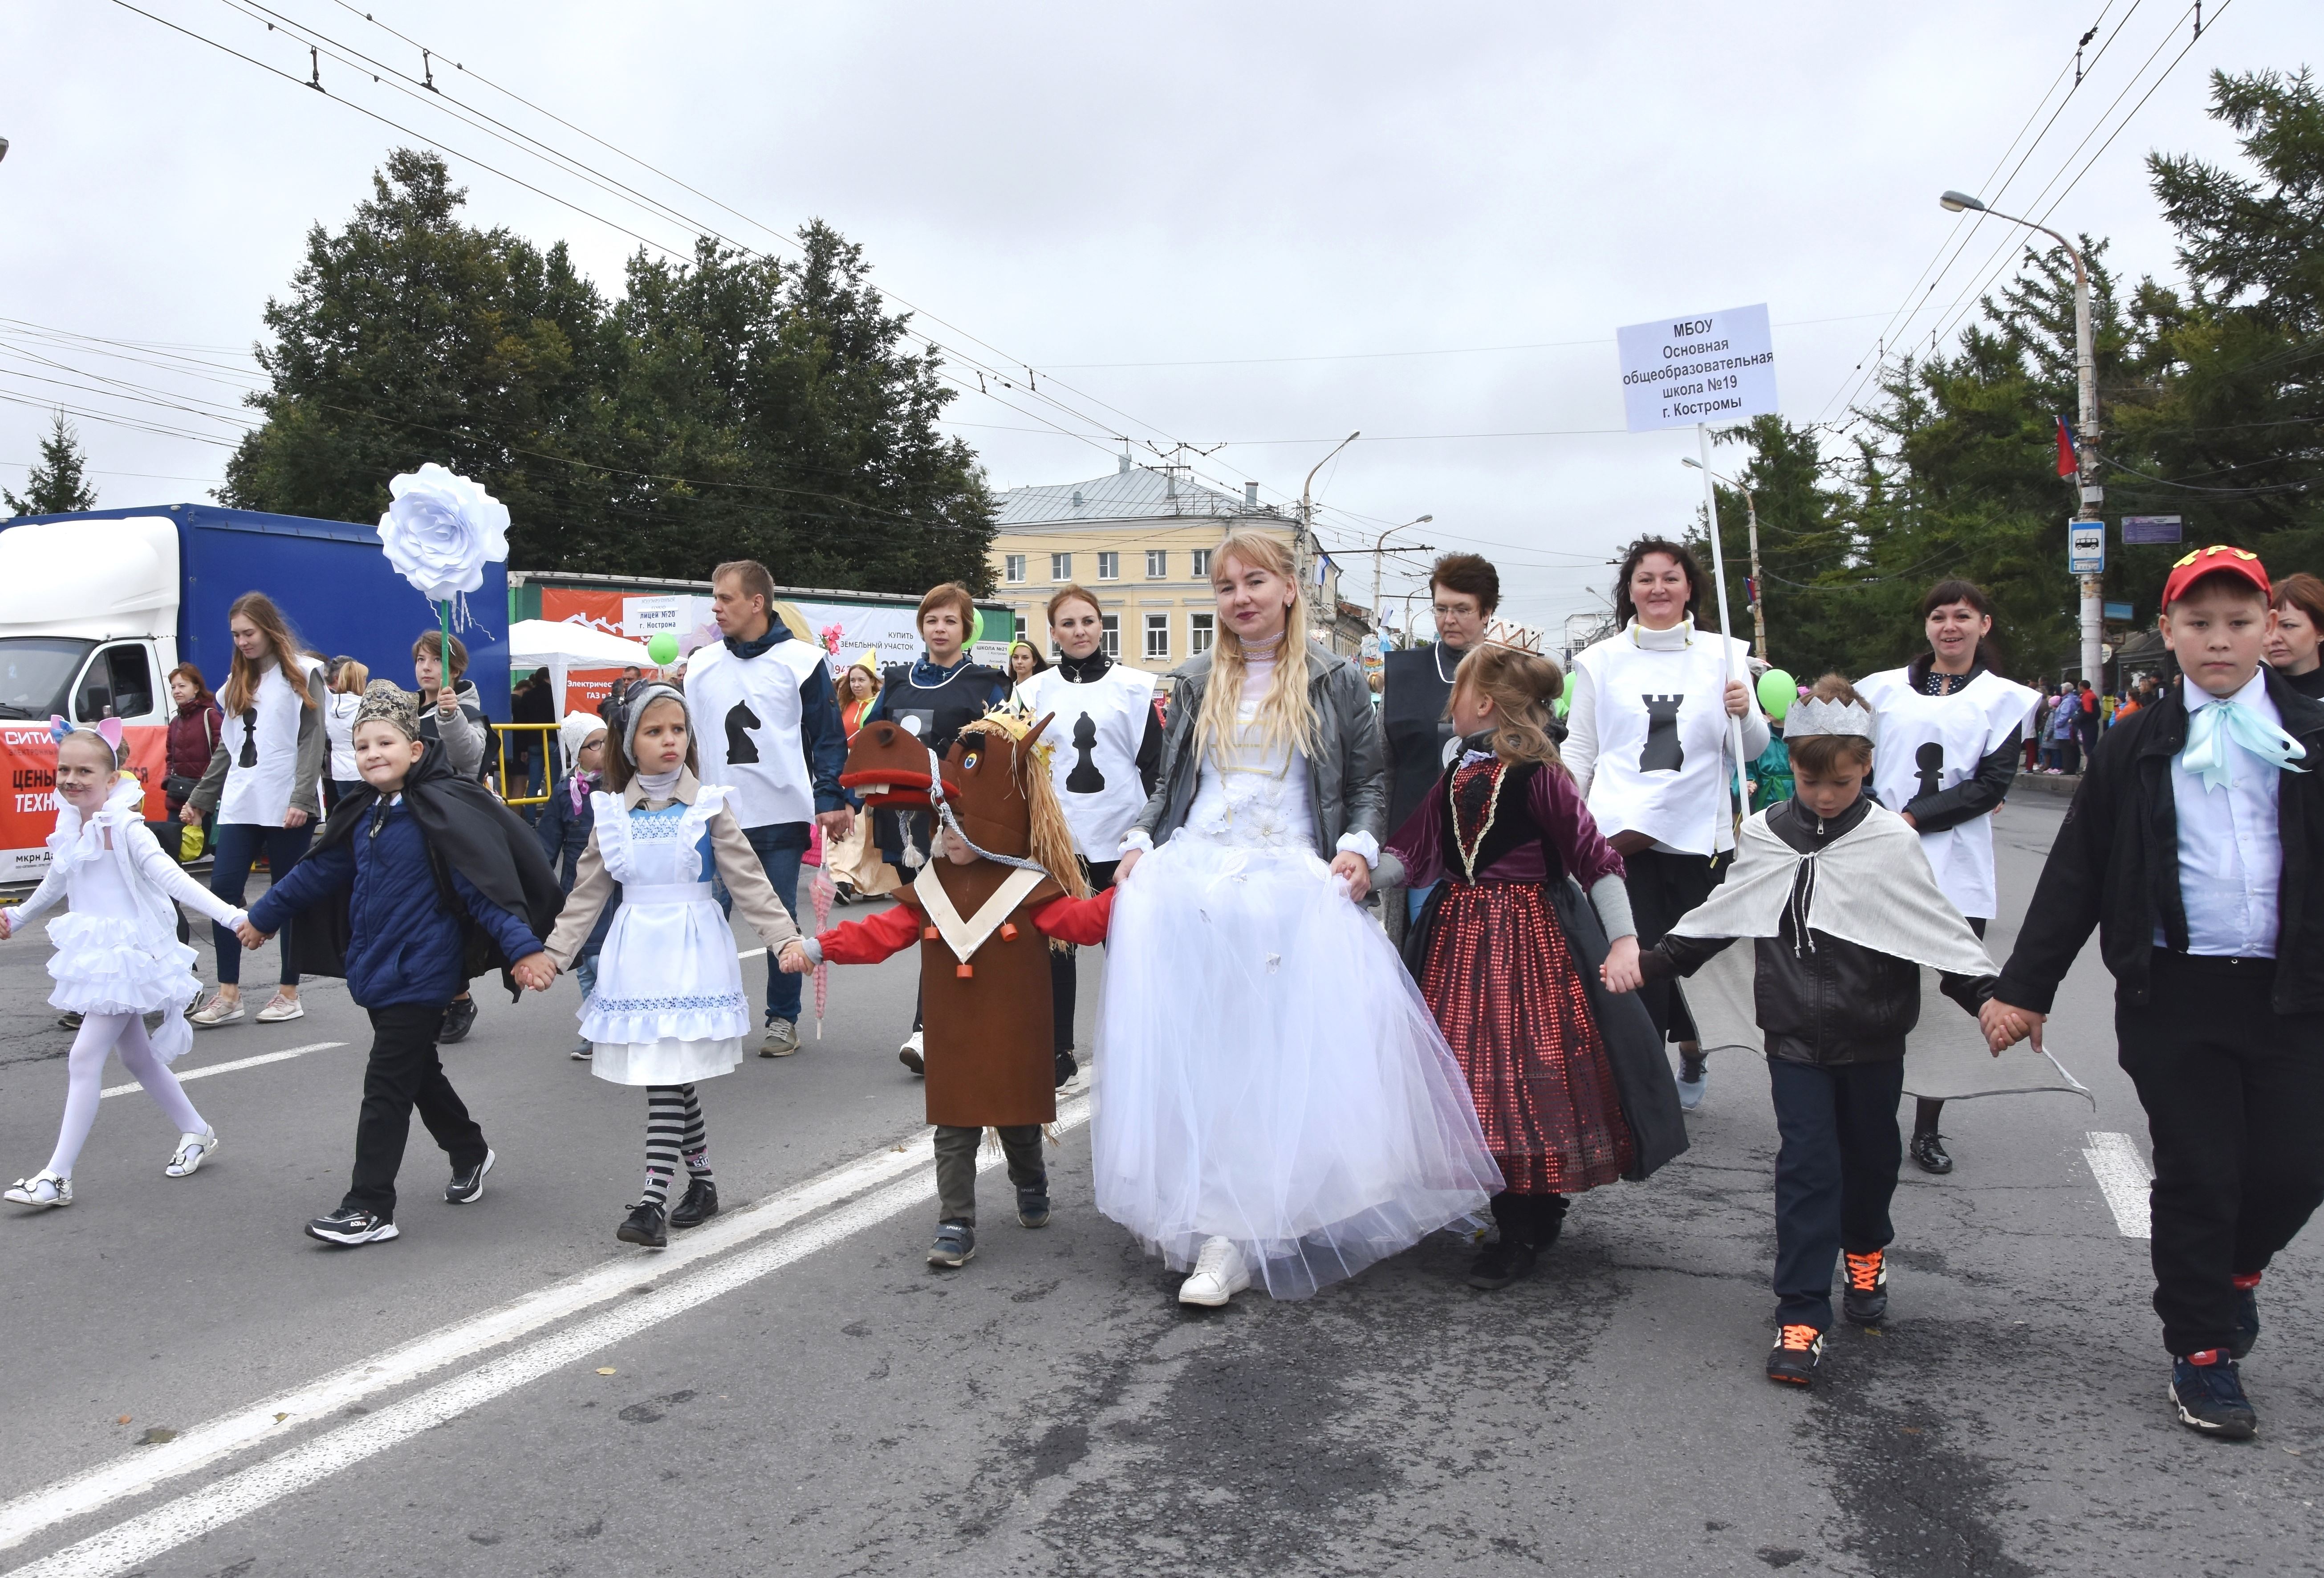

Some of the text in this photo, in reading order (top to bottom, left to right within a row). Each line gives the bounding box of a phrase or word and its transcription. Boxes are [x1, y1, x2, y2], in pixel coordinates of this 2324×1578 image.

[1674, 319, 1713, 338] МБОУ
[1663, 339, 1729, 359] Основная
[1623, 352, 1774, 385] общеобразовательная
[1663, 375, 1737, 399] школа №19
[1663, 397, 1741, 418] г. Костромы
[640, 611, 658, 619] лицей
[13, 769, 57, 791] ЦЕНЫ
[15, 793, 58, 813] ТЕХН
[16, 854, 41, 863] мкрн
